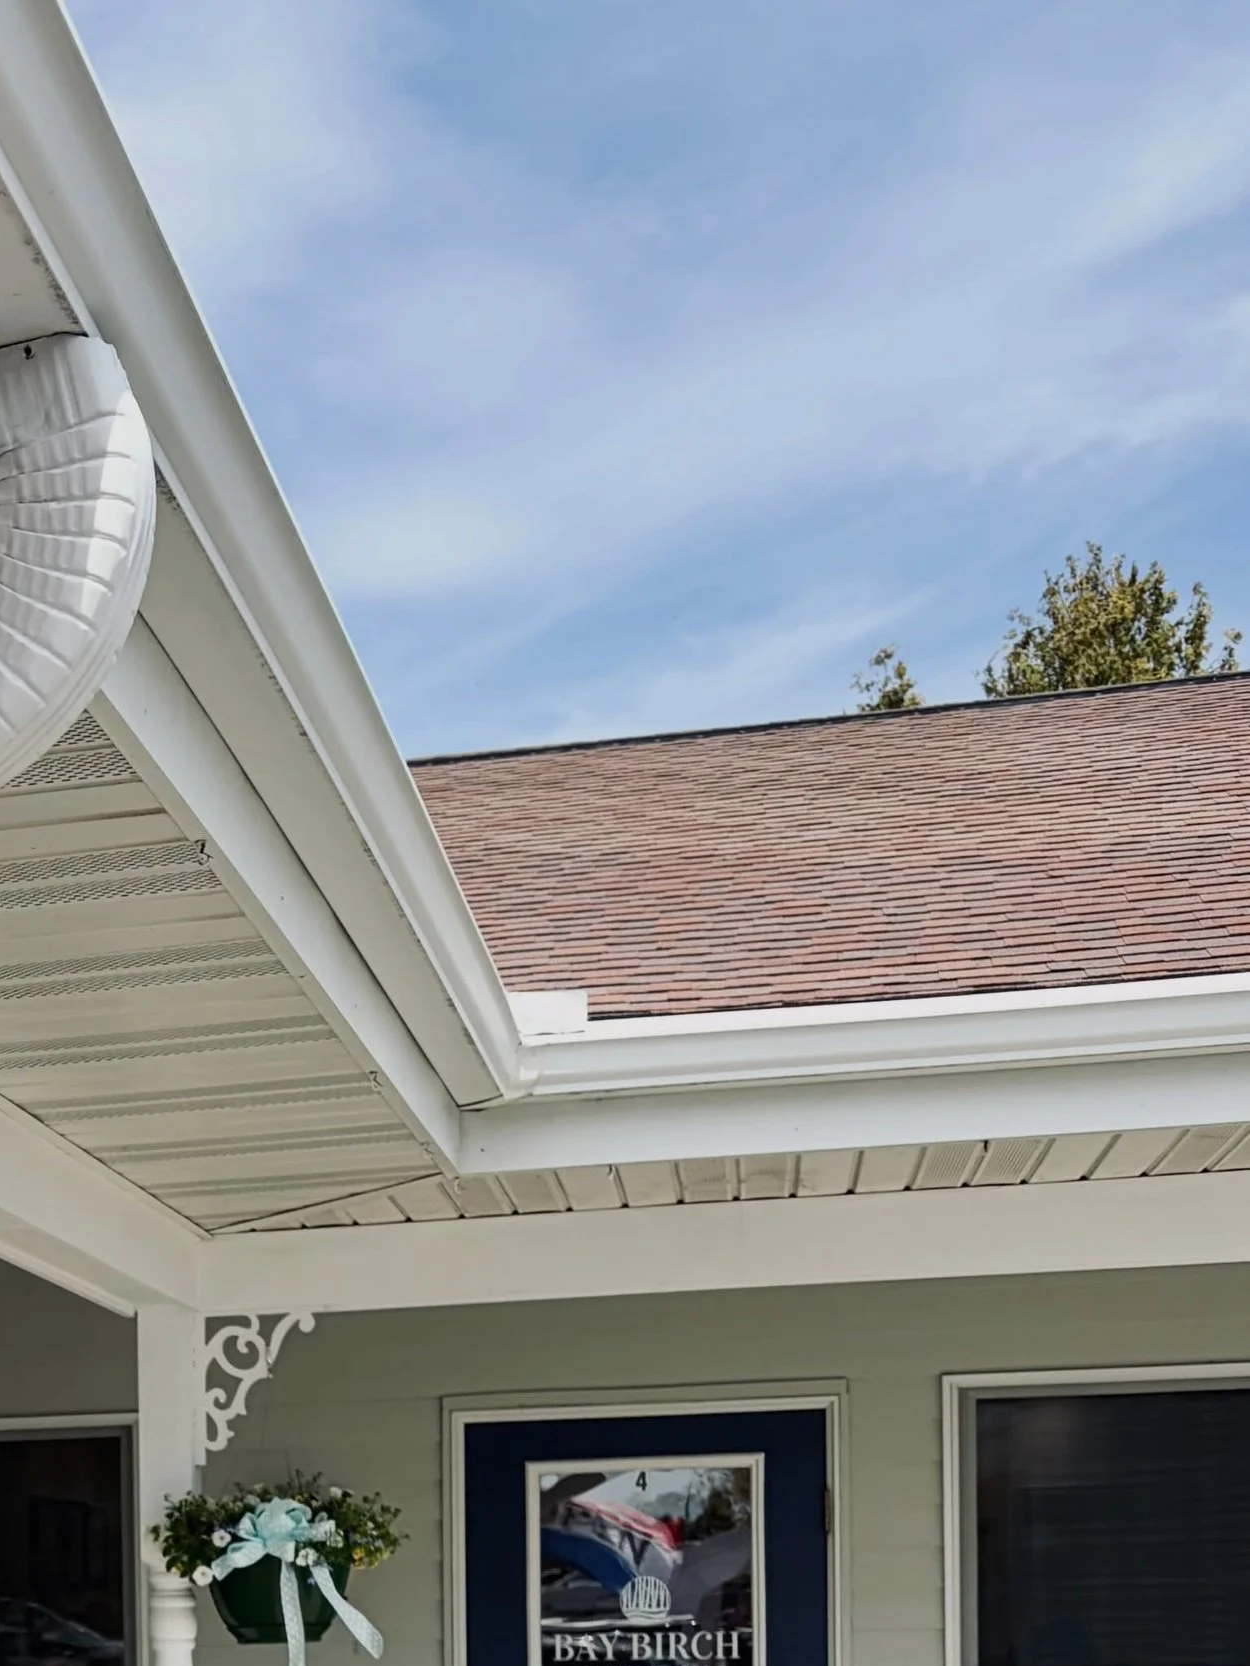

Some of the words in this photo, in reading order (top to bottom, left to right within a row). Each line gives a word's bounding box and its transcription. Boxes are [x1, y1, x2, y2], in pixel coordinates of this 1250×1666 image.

[635, 1471, 647, 1491] 4
[553, 1632, 620, 1662] BAY
[631, 1630, 741, 1661] BIRCH
